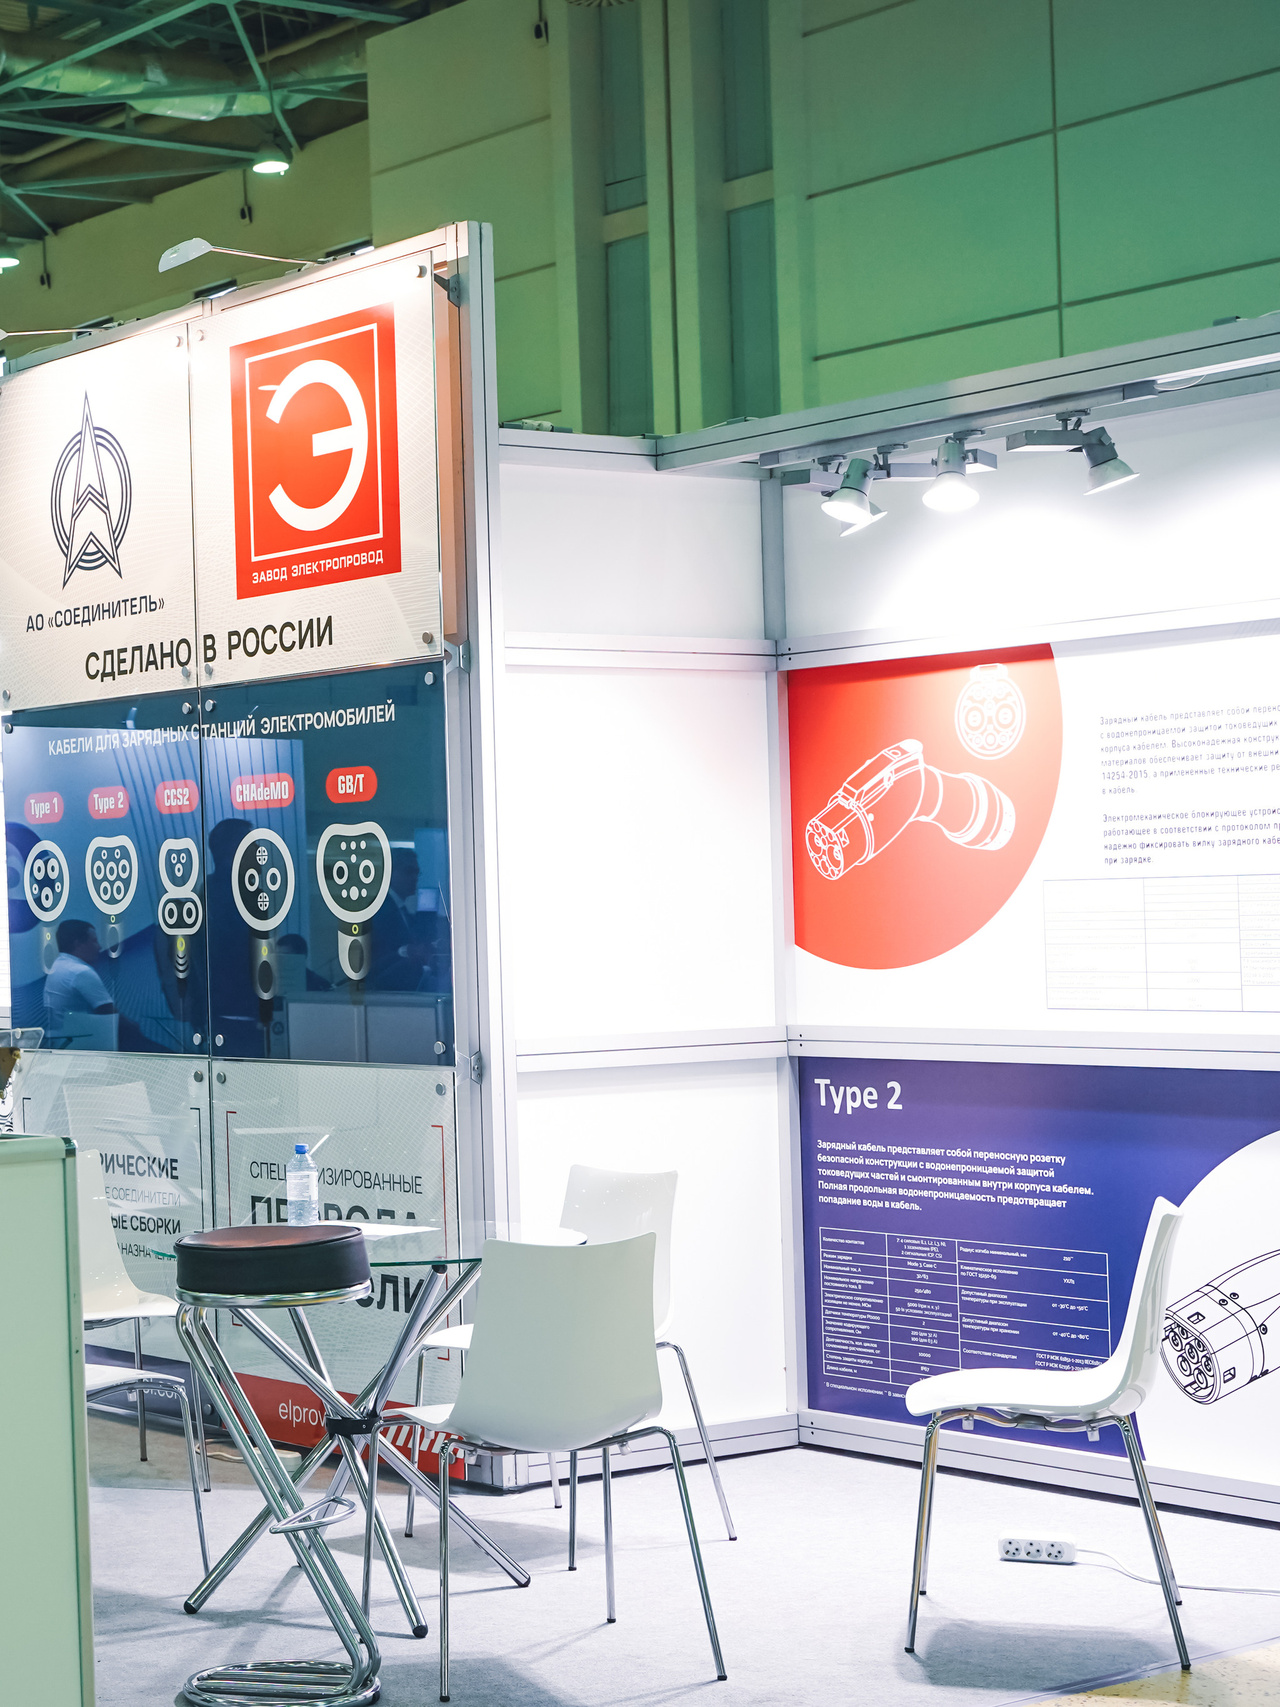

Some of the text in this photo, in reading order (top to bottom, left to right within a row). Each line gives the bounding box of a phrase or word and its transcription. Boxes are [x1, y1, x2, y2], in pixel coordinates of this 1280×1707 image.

[252, 549, 384, 584] ЗАВОД ЭЛЕКТРОПРОВОД
[26, 595, 165, 633] АО «СОЕДИНИТЕЛЬ»
[85, 615, 333, 682] СДЕЛАНО В РОССИИ
[1141, 713, 1167, 722] кабель
[1170, 708, 1224, 721] представляет
[1225, 720, 1278, 731] токоведущих
[48, 699, 396, 756] КАБЕЛИ ДЛЯ ЗАРЯДНЫХ СТАНЦИЙ ЭЛЕКТРОМОБИЛЕЙ
[1101, 744, 1131, 753] корпуса
[1171, 736, 1241, 749] Высоконадежная
[1101, 758, 1147, 768] материалов
[1149, 753, 1203, 765] обеспечивает
[1237, 751, 1245, 759] от
[1218, 763, 1268, 774] технические
[235, 781, 289, 803] CHAdeMO
[337, 773, 365, 795] GB/T
[30, 797, 58, 819] Type 1
[93, 791, 124, 814] Type 2
[164, 787, 190, 807] CCS2
[1103, 811, 1189, 823] Электромеханическое
[1191, 809, 1247, 819] блокирующее
[1103, 827, 1151, 838] работающее
[1160, 825, 1212, 835] соответствии
[1222, 822, 1271, 833] протоколом
[1104, 842, 1137, 851] надежно
[1139, 840, 1190, 851] фиксировать
[1192, 840, 1215, 848] вилку
[1218, 837, 1260, 847] зарядного
[1104, 856, 1154, 866] при зарядке.
[814, 1078, 903, 1115] Type 2
[817, 1139, 1066, 1166] Зарядный кабель представляет собой переносную розетку
[817, 1153, 864, 1165] безопасной
[865, 1158, 918, 1170] конструкции
[925, 1162, 1015, 1176] водонепроницаемой
[1016, 1167, 1055, 1178] защитой
[250, 1160, 423, 1195] СПЕЦИЗИРОВАННЫЕ
[817, 1168, 870, 1180] токоведущих
[871, 1171, 899, 1181] частей
[907, 1174, 981, 1188] смонтированным
[982, 1180, 1013, 1191] внутри
[1014, 1182, 1051, 1194] корпуса
[1052, 1184, 1094, 1196] кабелем.
[818, 1180, 1067, 1208] Полная продольная водонепроницаемость предотвращает
[818, 1195, 861, 1206] попадание
[862, 1199, 884, 1208] воды
[891, 1200, 922, 1211] кабель.
[130, 1215, 181, 1235] СБОРКИ
